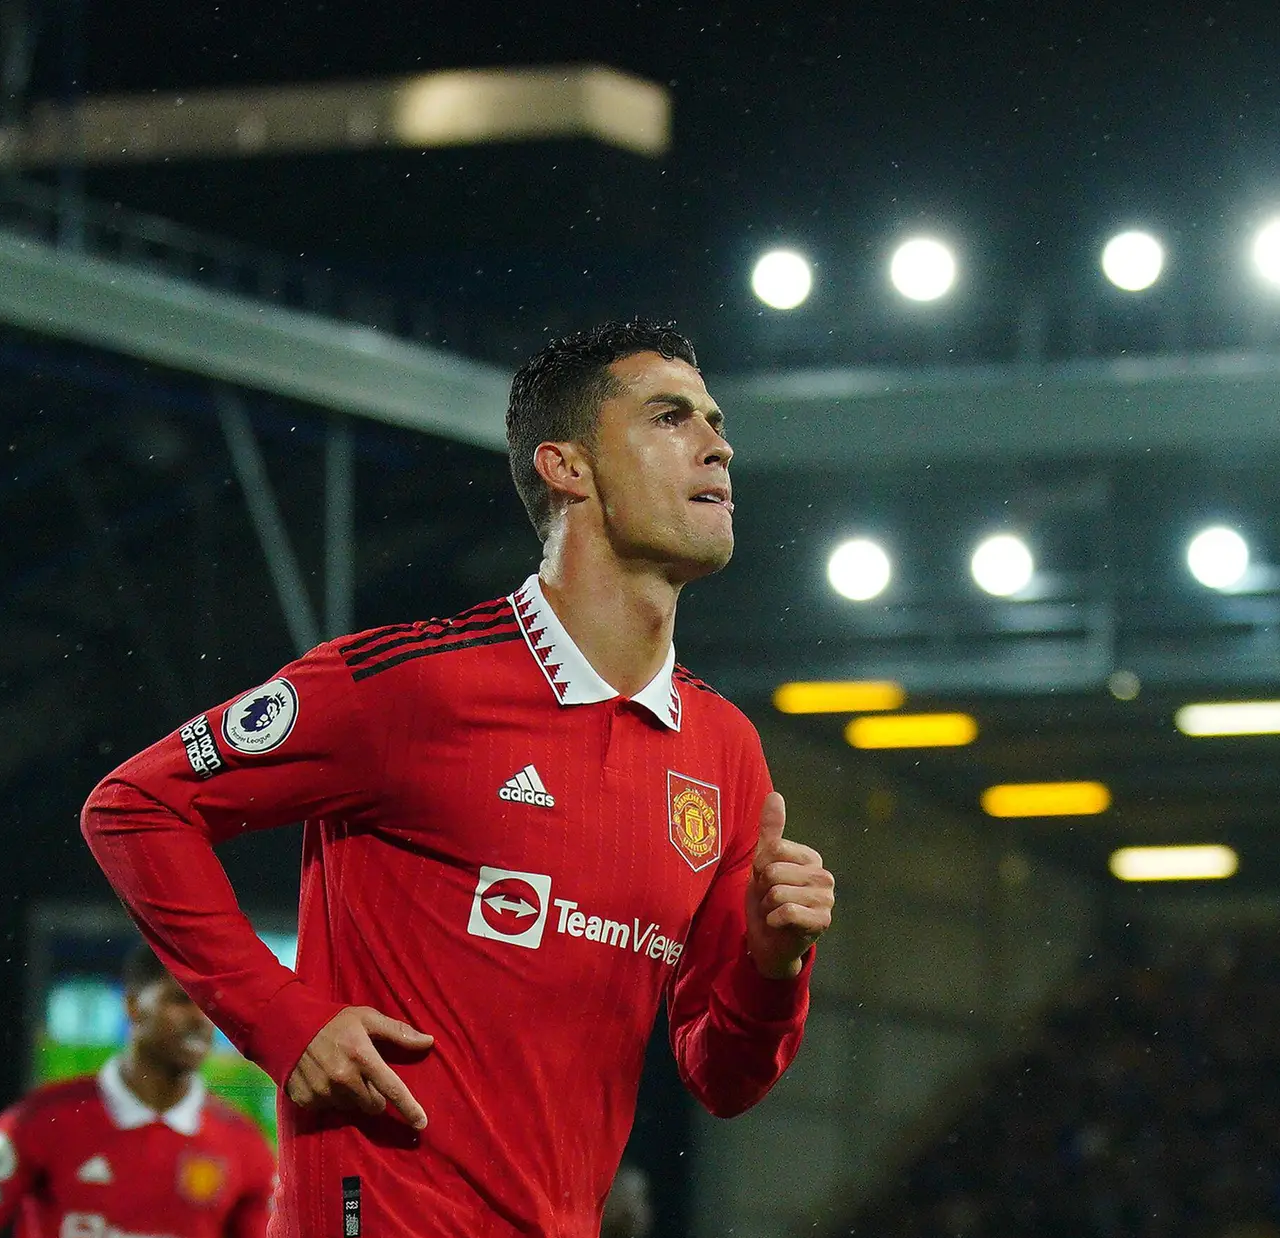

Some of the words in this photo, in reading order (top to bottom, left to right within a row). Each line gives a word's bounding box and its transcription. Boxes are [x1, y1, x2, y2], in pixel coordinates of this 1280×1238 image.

[180, 723, 195, 741] for
[192, 714, 207, 736] No
[246, 733, 271, 745] League
[186, 740, 212, 779] racism
[199, 733, 221, 769] room
[499, 787, 555, 807] adidas
[553, 898, 684, 967] TeamViewe
